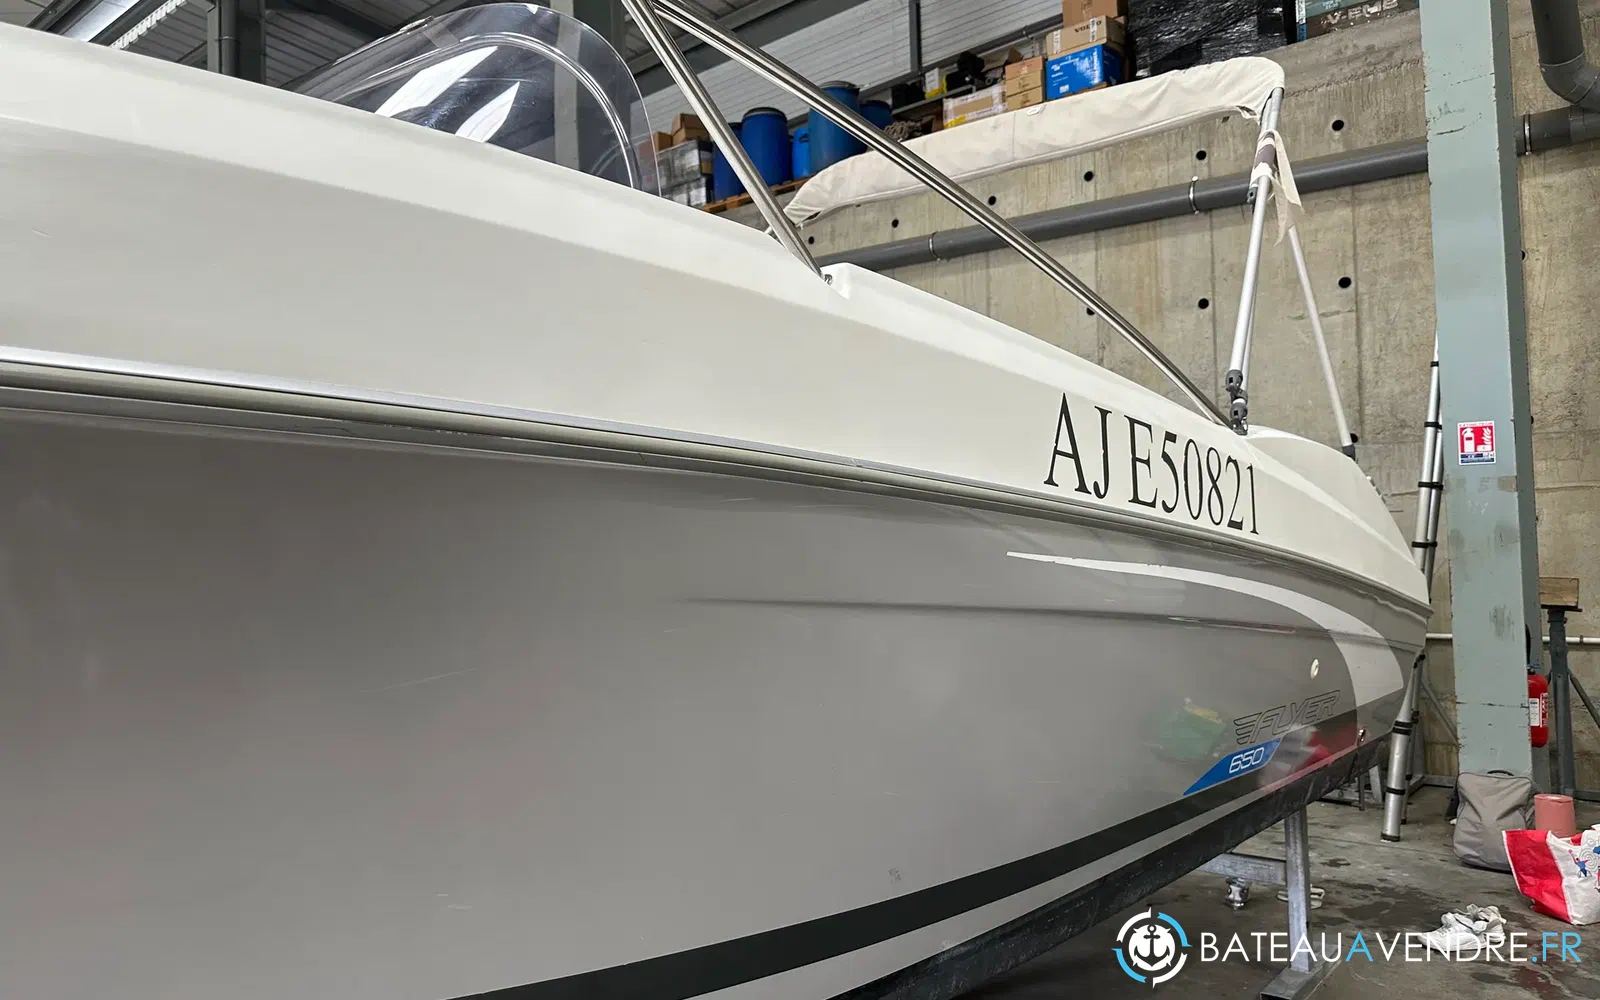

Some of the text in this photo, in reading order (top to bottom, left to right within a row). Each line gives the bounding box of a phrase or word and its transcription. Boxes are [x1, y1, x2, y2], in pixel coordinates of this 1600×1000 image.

[1074, 20, 1102, 33] VOLO
[1233, 690, 1341, 745] FLYER
[1229, 747, 1265, 774] 650
